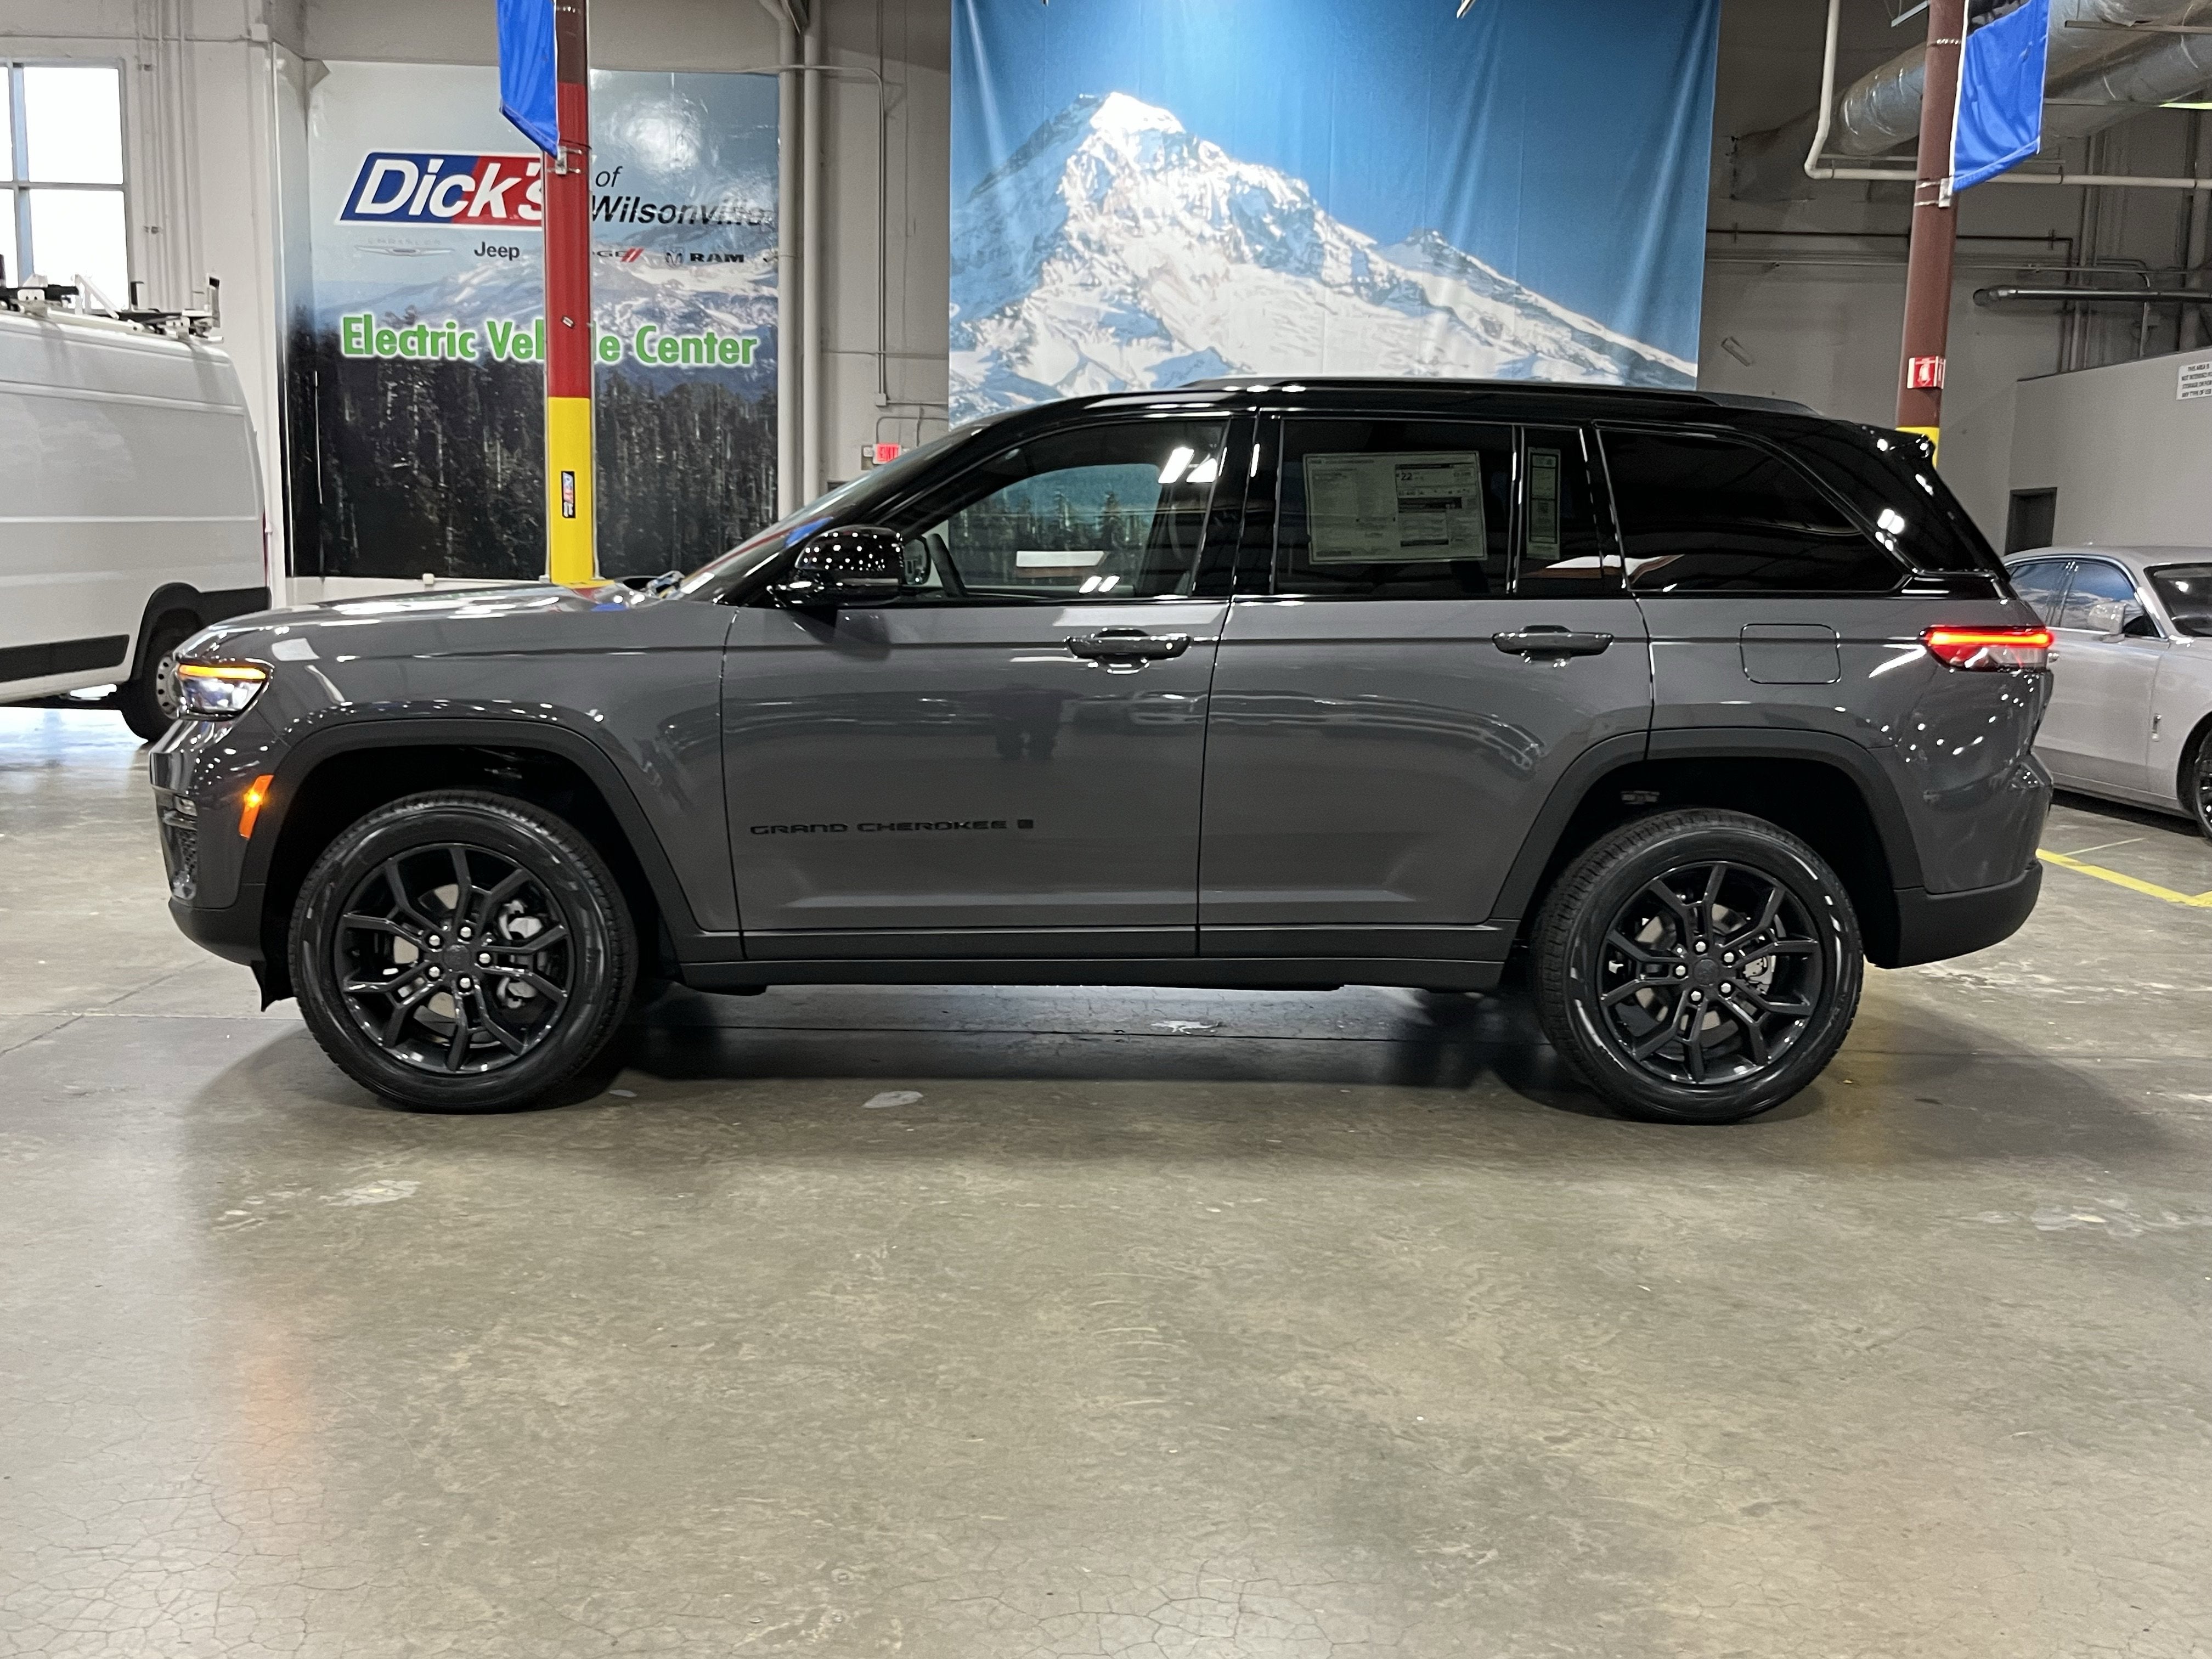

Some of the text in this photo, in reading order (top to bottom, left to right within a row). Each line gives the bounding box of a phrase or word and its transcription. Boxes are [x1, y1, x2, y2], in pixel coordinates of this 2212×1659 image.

[595, 165, 623, 188] of
[354, 158, 541, 221] Dick's
[473, 241, 521, 261] Jeep
[690, 252, 745, 263] RAM
[343, 314, 758, 364] Electric Vele Center
[879, 445, 899, 460] EXIT
[1401, 472, 1413, 481] 22
[750, 820, 1007, 834] GRAND CHEROKEE
